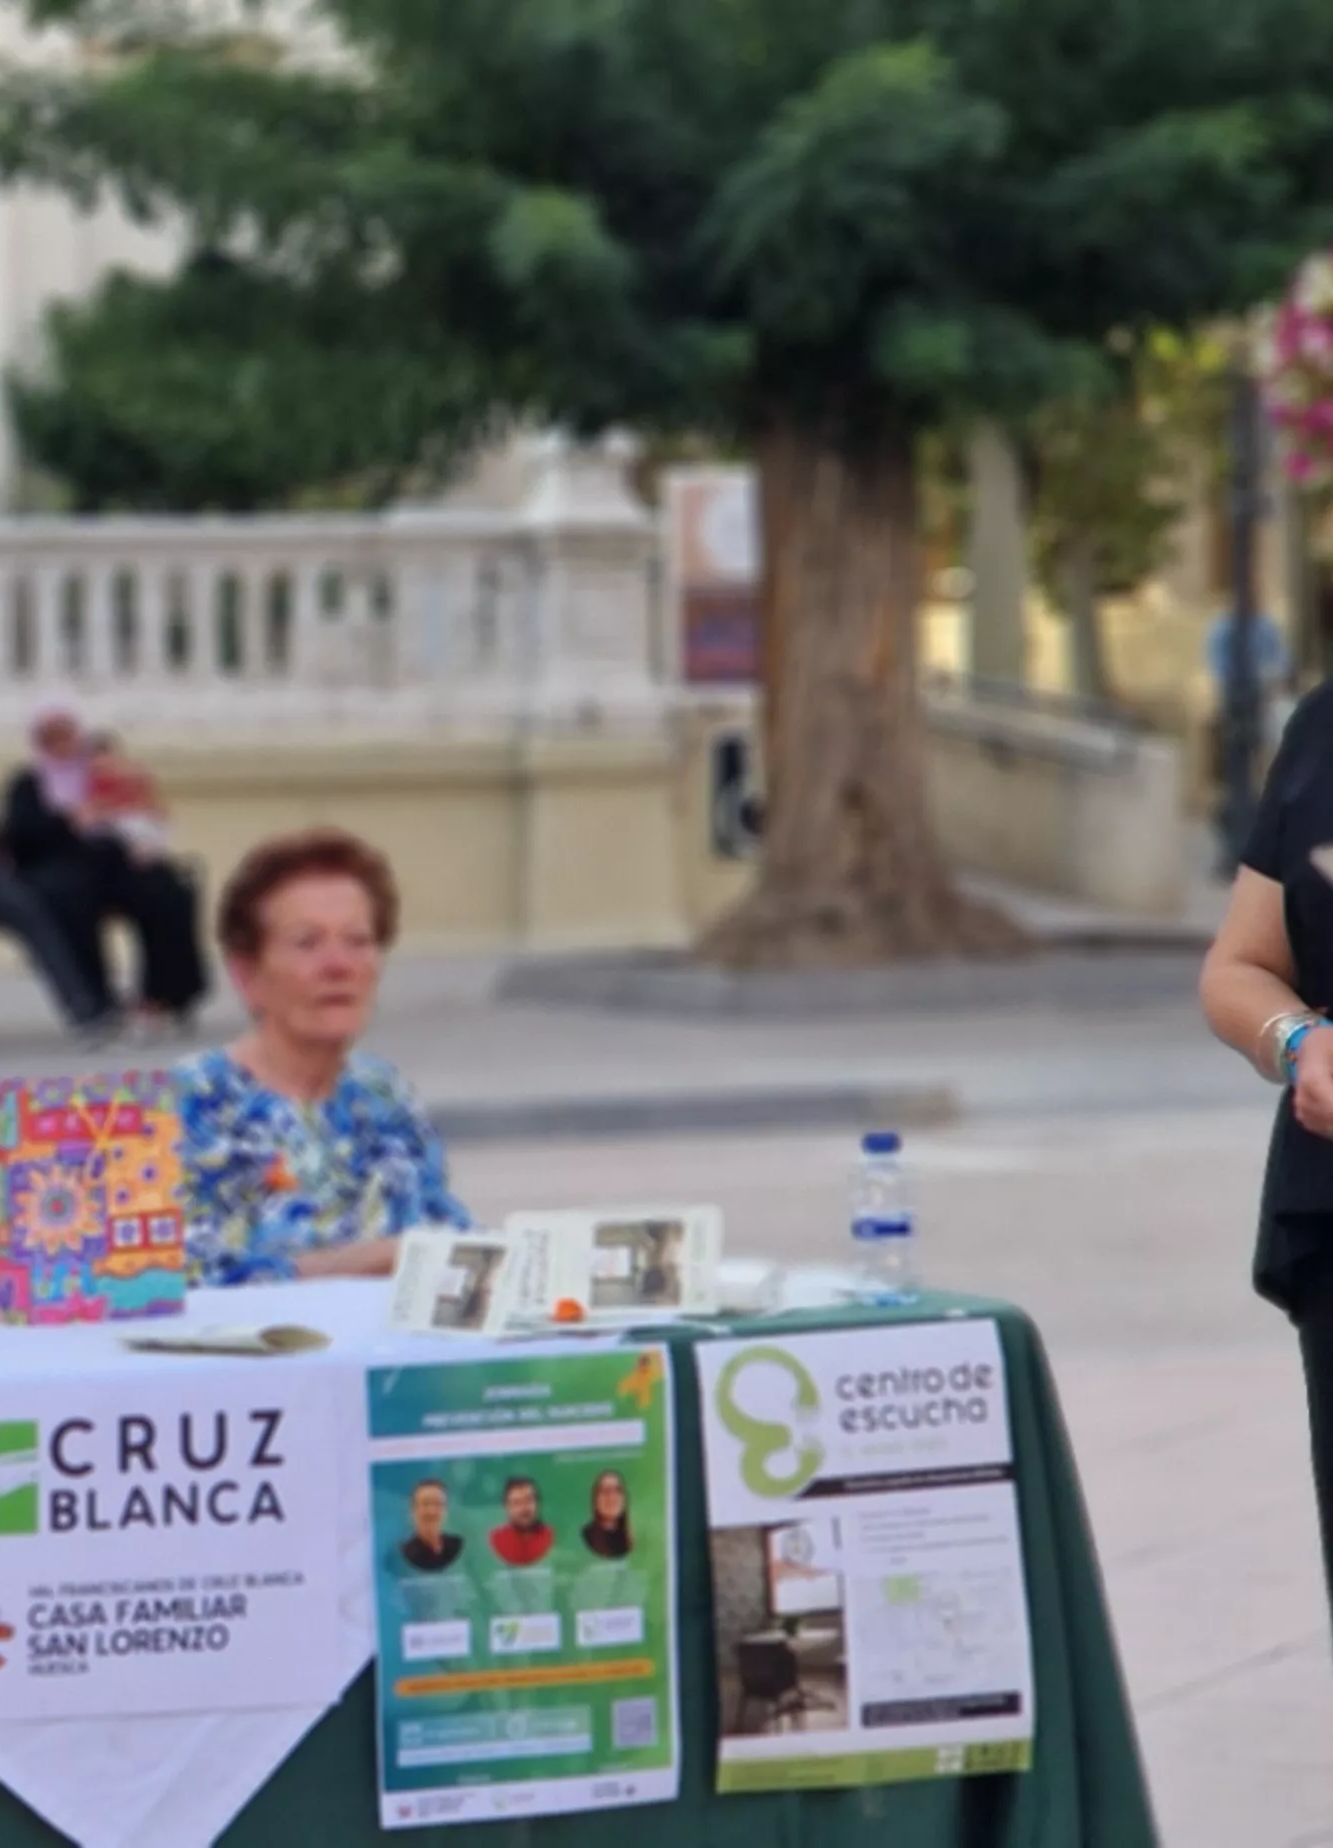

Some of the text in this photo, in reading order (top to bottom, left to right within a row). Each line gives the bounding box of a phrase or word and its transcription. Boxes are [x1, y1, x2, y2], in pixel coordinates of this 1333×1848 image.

[836, 1368, 946, 1402] centro
[839, 1397, 989, 1435] escucha
[49, 1409, 287, 1477] CRUZ
[49, 1480, 286, 1534] BLANCA
[27, 1592, 247, 1631] CASA FAMILIAR
[27, 1622, 230, 1661] SAN LORENZO
